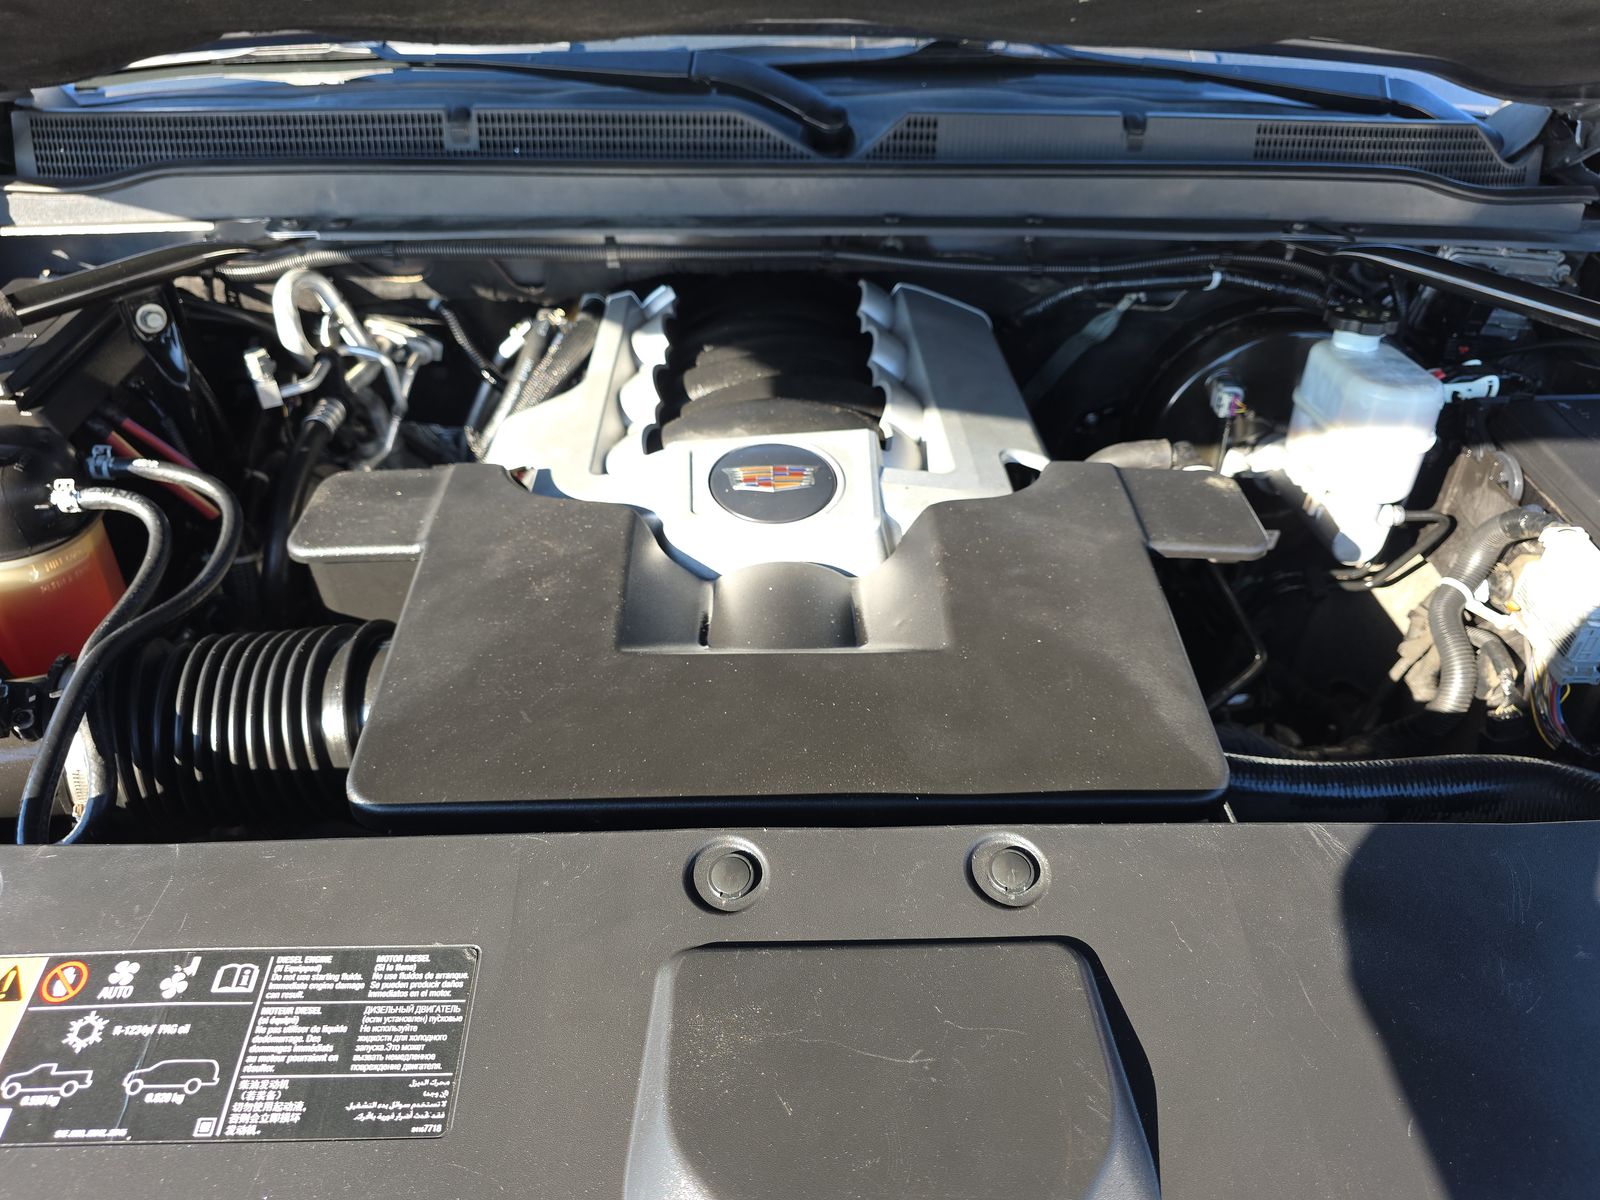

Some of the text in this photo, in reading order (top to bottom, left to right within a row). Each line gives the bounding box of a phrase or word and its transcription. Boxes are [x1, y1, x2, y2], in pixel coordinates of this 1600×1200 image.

[395, 963, 416, 972] tiene)
[311, 973, 340, 982] starting
[309, 982, 334, 990] engine
[335, 982, 365, 990] damage
[381, 981, 409, 990] pueden
[410, 980, 441, 989] producir
[97, 986, 134, 999] AUTO
[261, 1007, 294, 1015] MOTEUR
[363, 1004, 461, 1015] ДИЗЕЛЬНЫЙ ДВИГАТЕЛЬ
[362, 1016, 382, 1024] (если
[383, 1015, 428, 1024] установлен)
[255, 1026, 267, 1034] Ne
[267, 1027, 282, 1035] pas
[310, 1025, 321, 1033] de
[322, 1025, 348, 1034] liquide
[372, 1024, 418, 1033] используйте
[306, 1034, 321, 1043] Des
